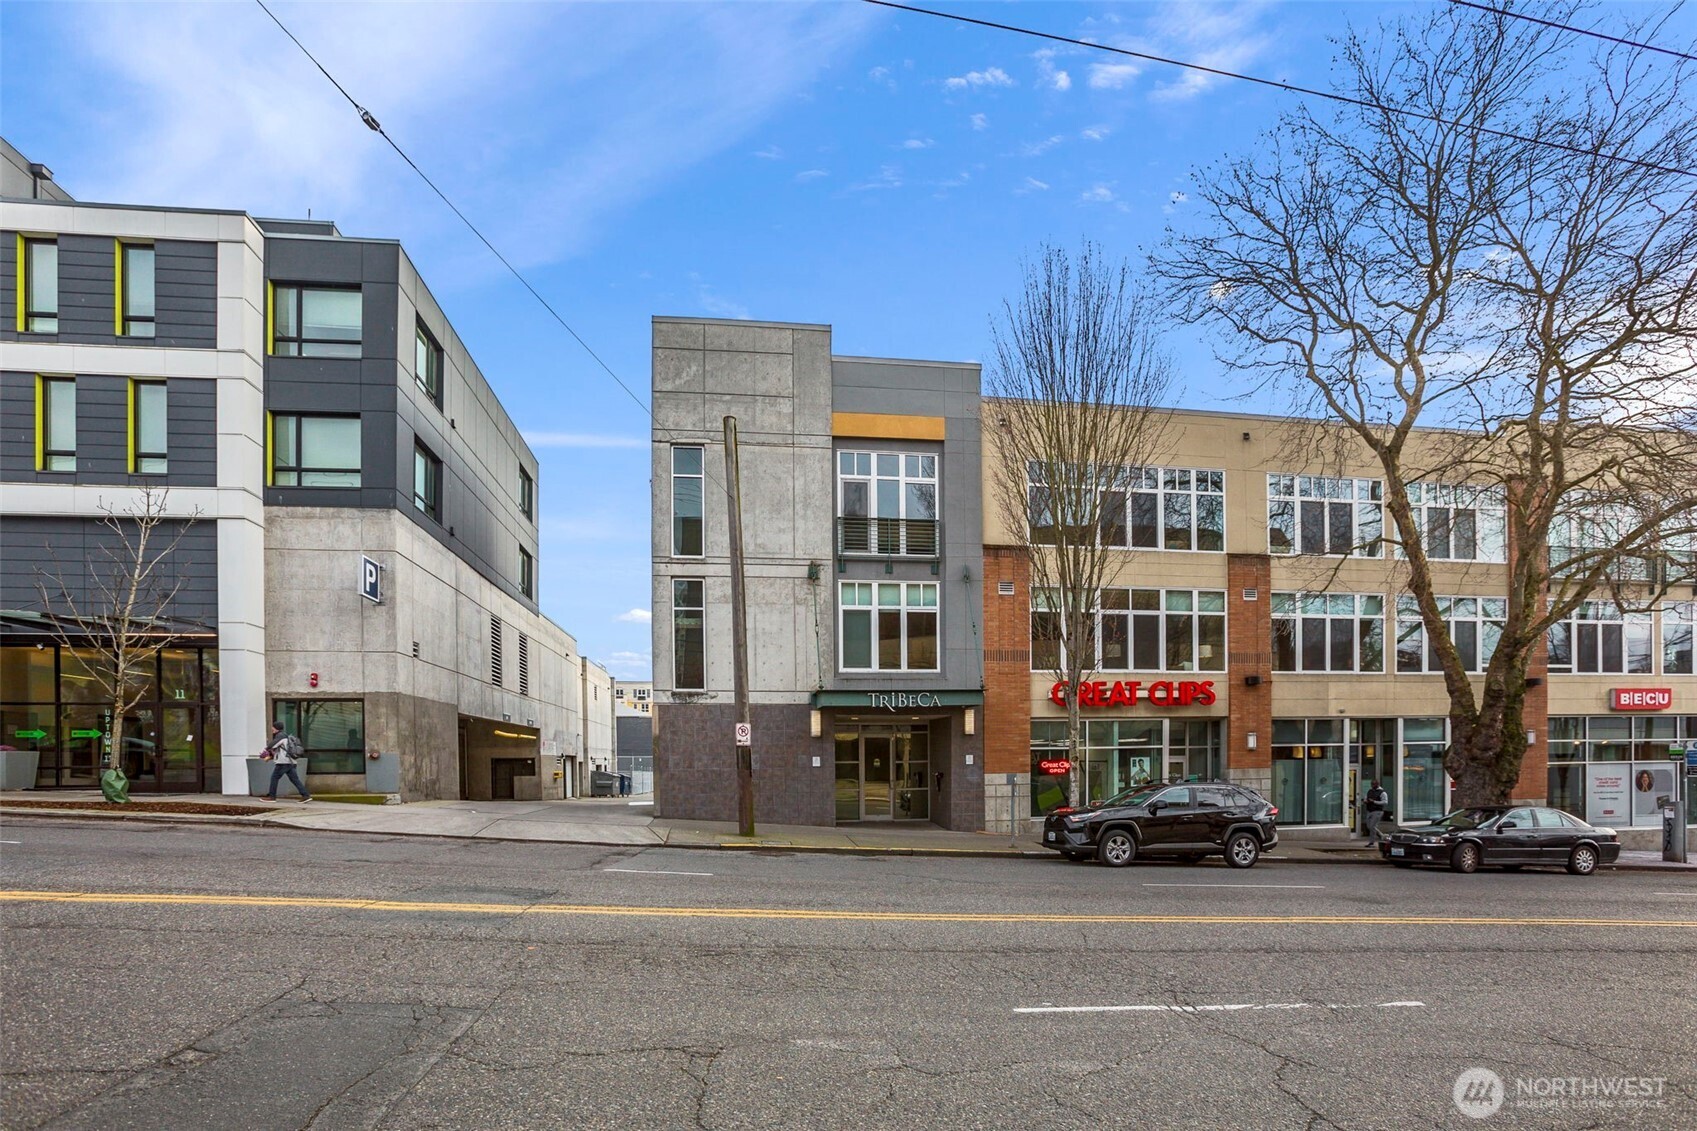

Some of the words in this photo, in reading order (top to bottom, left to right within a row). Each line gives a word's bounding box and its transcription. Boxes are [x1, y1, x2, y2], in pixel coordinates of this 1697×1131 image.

[366, 562, 376, 592] P
[174, 689, 186, 699] 11
[1051, 681, 1141, 706] GREAT
[1148, 681, 1216, 706] CLIPS
[104, 709, 112, 753] UPTOWN
[1041, 761, 1058, 769] Great
